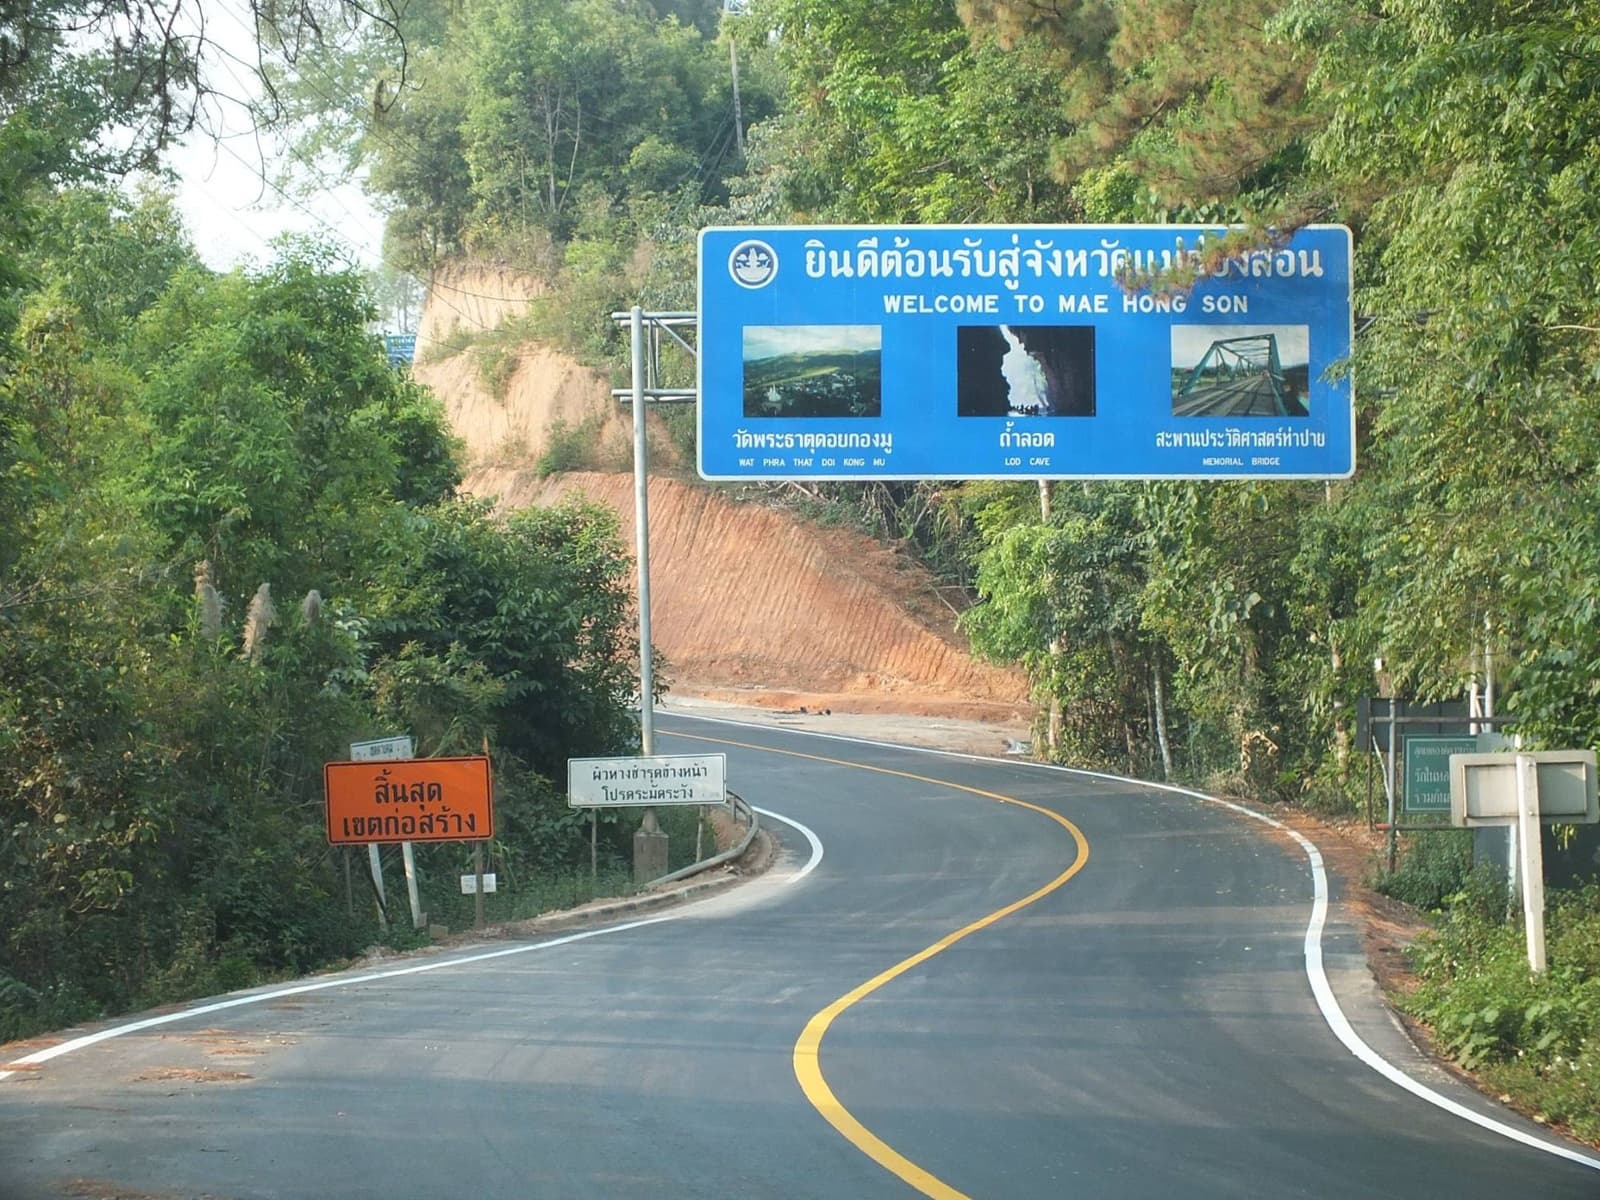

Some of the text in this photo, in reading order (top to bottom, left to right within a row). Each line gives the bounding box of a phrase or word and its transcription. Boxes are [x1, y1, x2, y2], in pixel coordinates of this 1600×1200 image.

[883, 294, 1249, 314] WELCOME TO MAE HONG SON
[732, 428, 893, 454] วัดพระธาตุดอยกองมู
[999, 420, 1056, 448] ถ้ำลอด
[1155, 426, 1326, 448] สะพานประวัติศาสตร์ท่าปาย
[739, 458, 886, 467] WAT PHRA THAT DOI KONG MU
[1005, 457, 1051, 466] LOD CAVE
[1202, 457, 1281, 466] MEMORIAL BRIDGE
[374, 768, 443, 812] สิ้นสุด
[601, 784, 694, 801] โปรดระมัดระวัง
[343, 805, 476, 837] เขตก่อสร้าง
